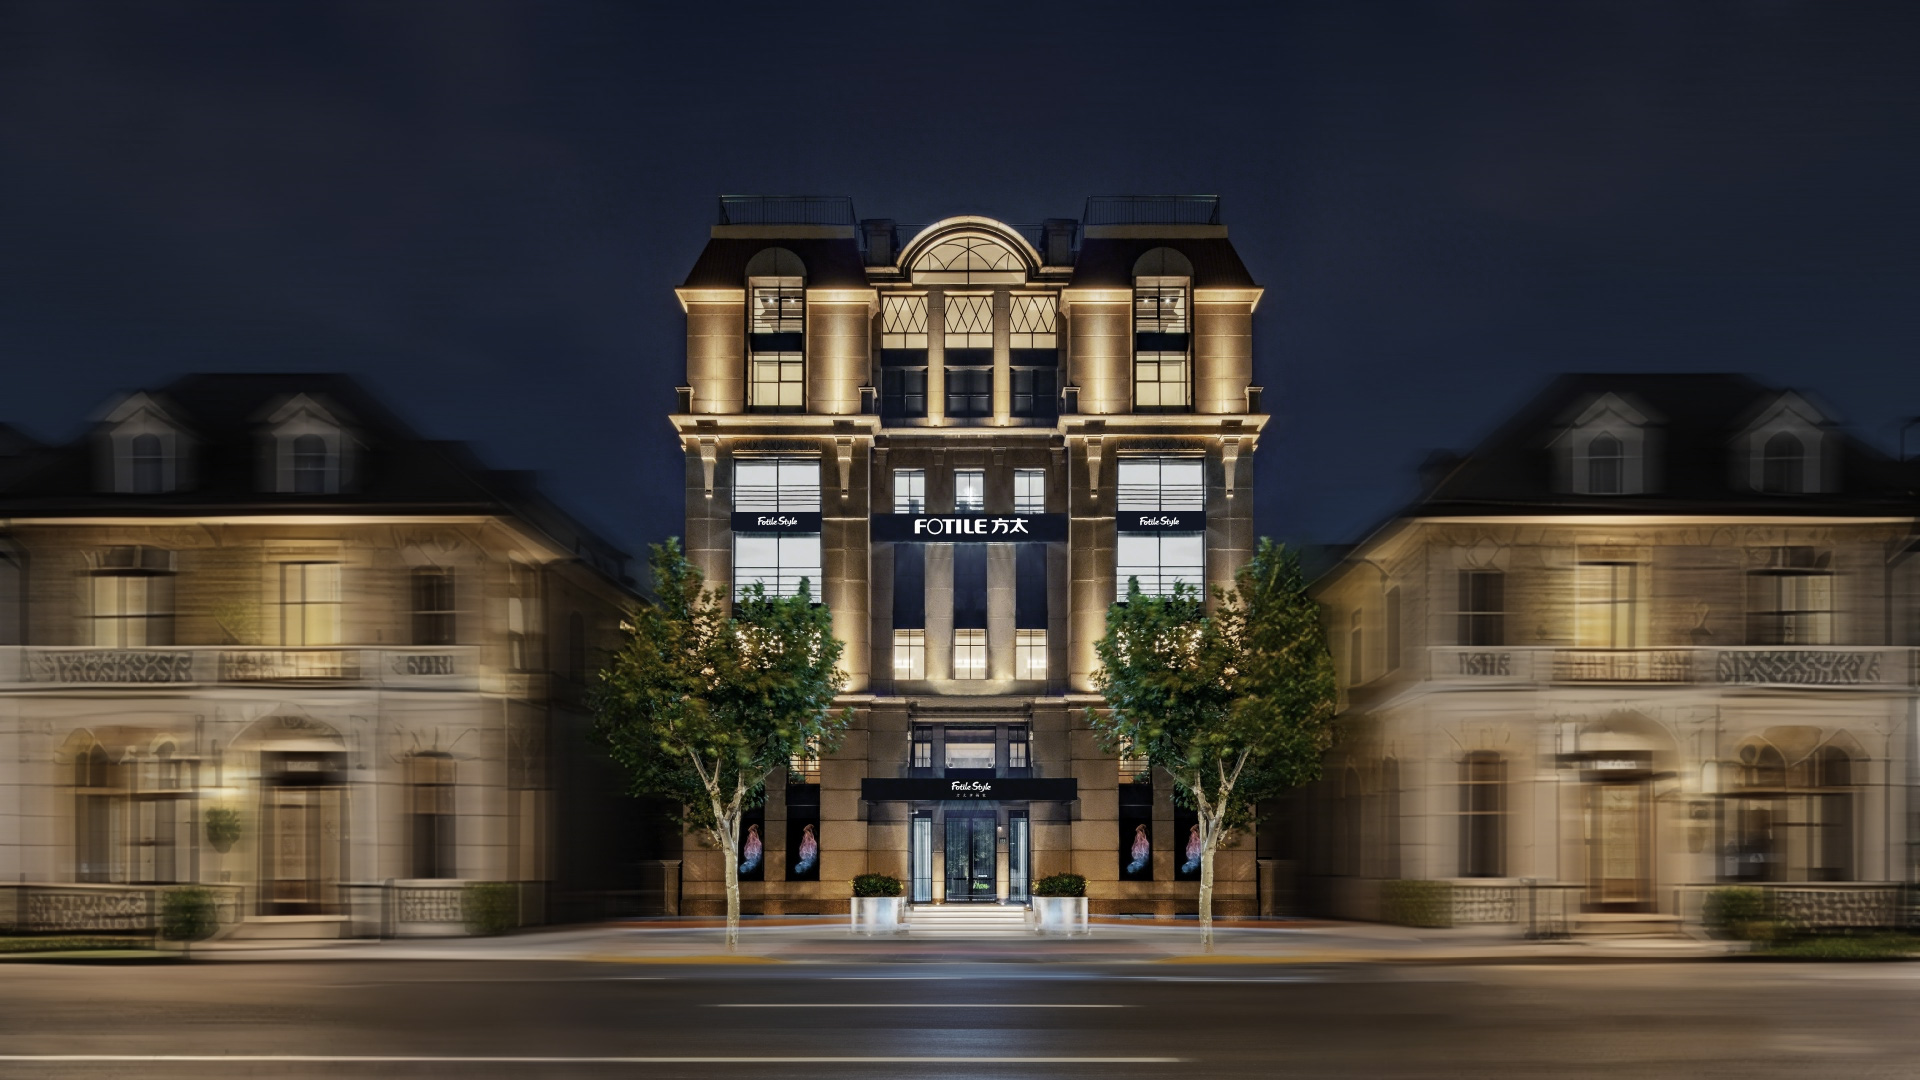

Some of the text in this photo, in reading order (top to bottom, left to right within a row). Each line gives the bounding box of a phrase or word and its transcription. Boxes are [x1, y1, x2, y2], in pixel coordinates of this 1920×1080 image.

[757, 516, 798, 527] Fotile Style
[914, 518, 1029, 535] FOTILE 方太
[1139, 516, 1180, 527] Fotile Style
[951, 781, 991, 792] Fotile Style
